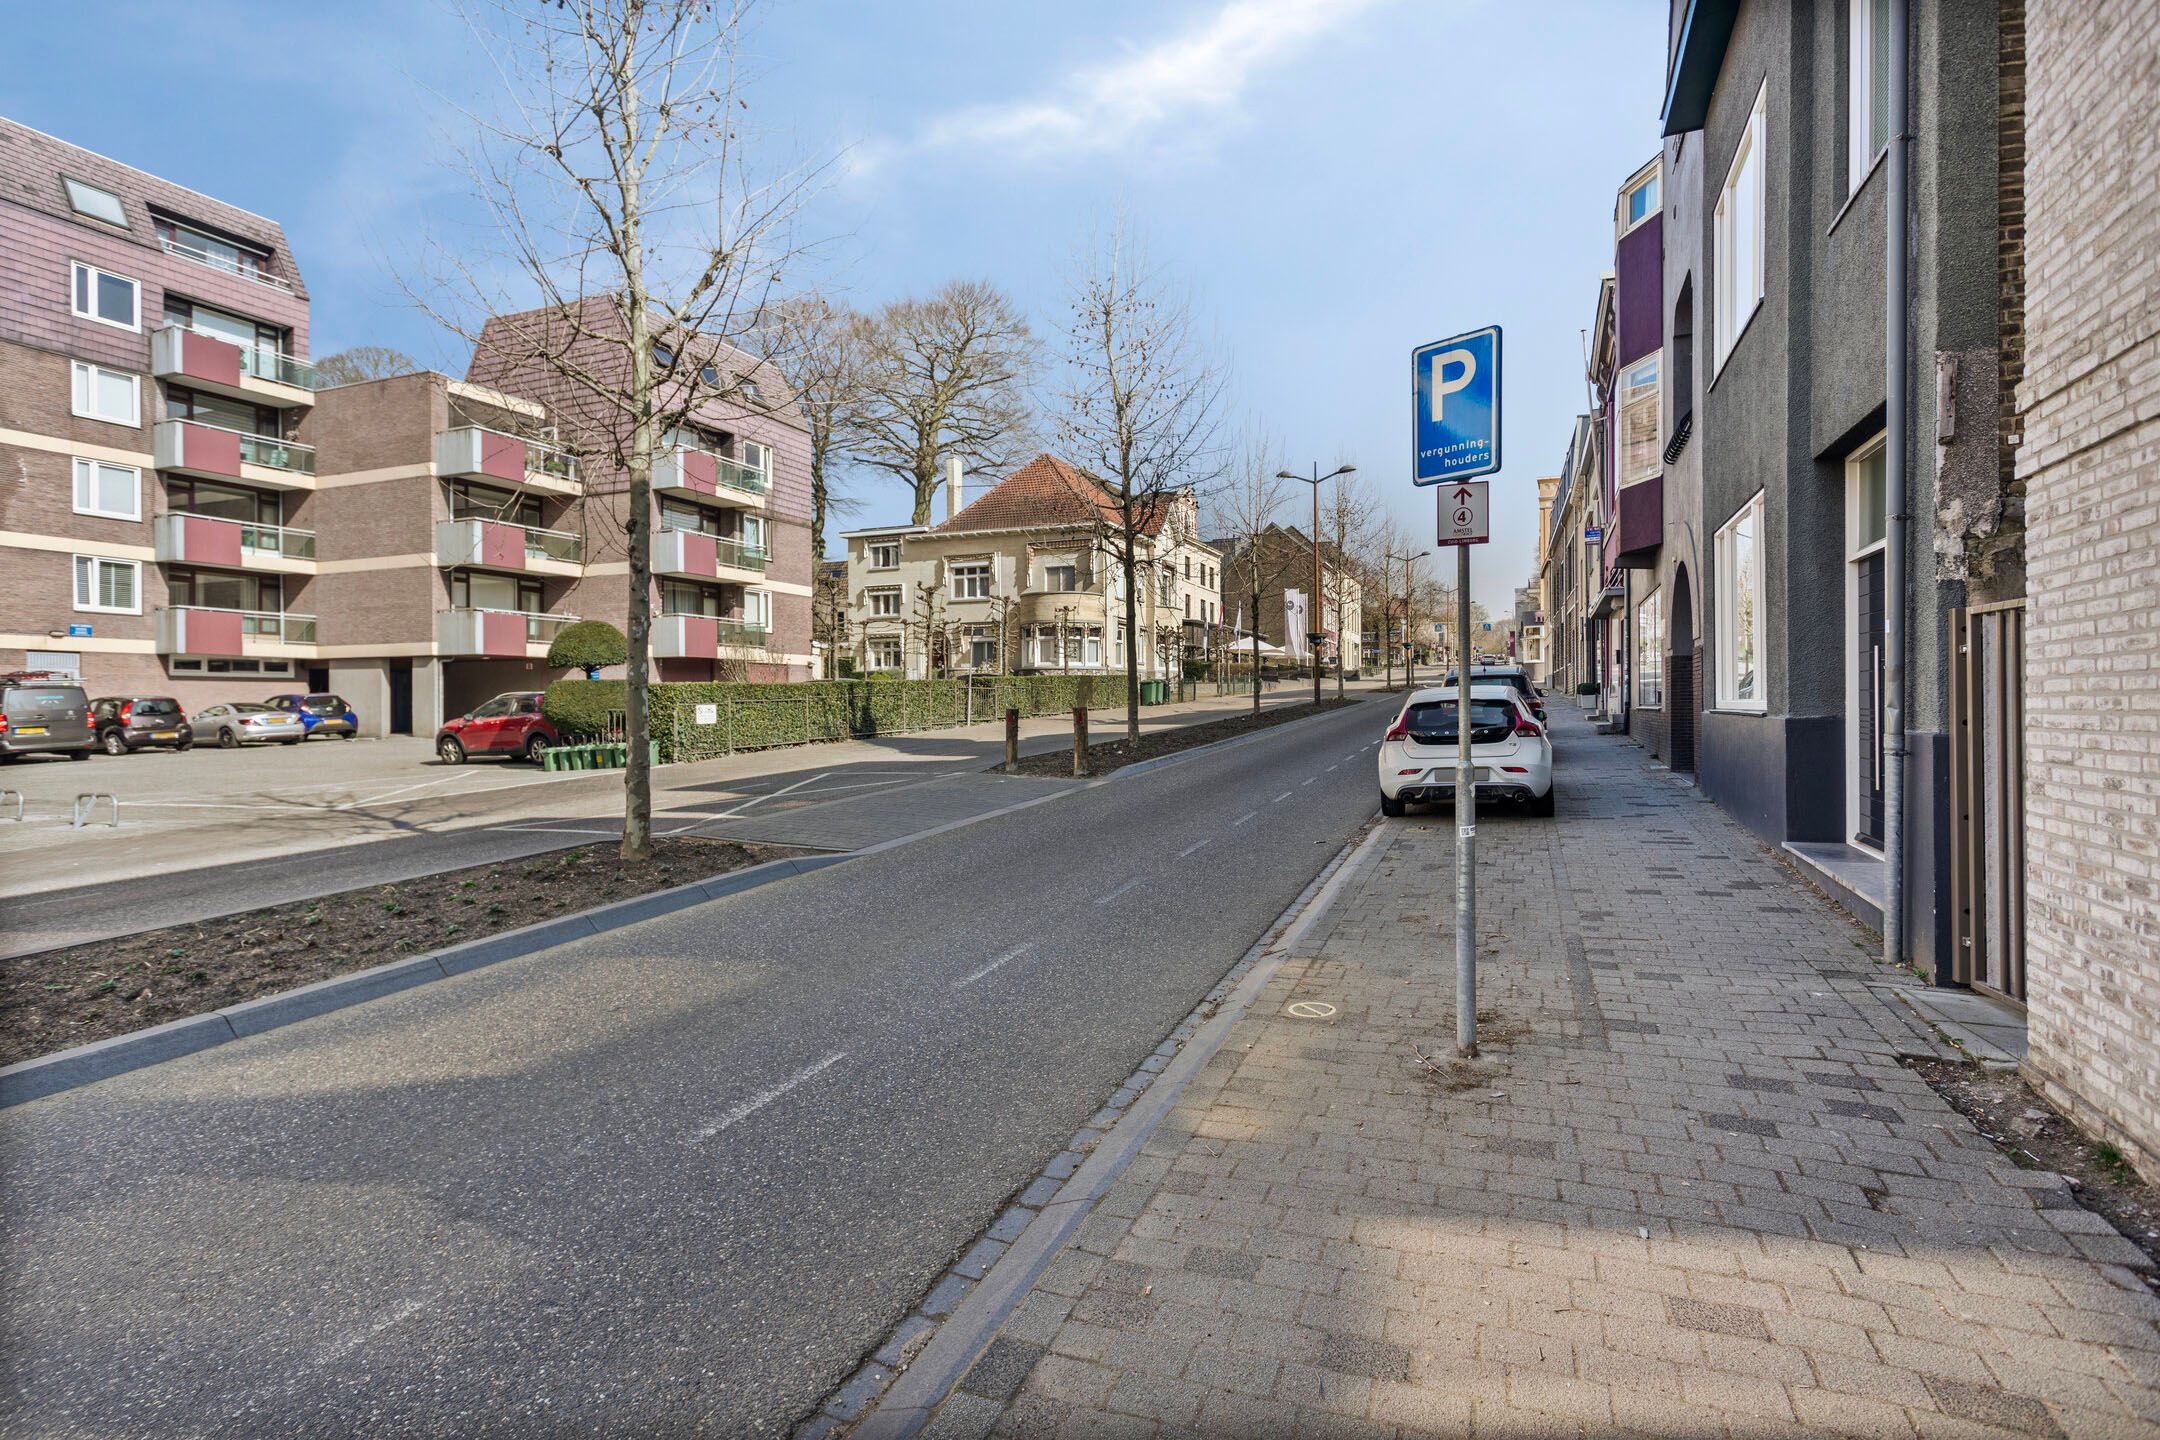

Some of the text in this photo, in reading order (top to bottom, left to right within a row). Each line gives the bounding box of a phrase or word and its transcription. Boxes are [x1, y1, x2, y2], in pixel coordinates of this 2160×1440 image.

[1432, 349, 1476, 422] P
[1420, 439, 1490, 459] vergunning-
[1444, 452, 1490, 467] houders
[1457, 511, 1466, 522] 4
